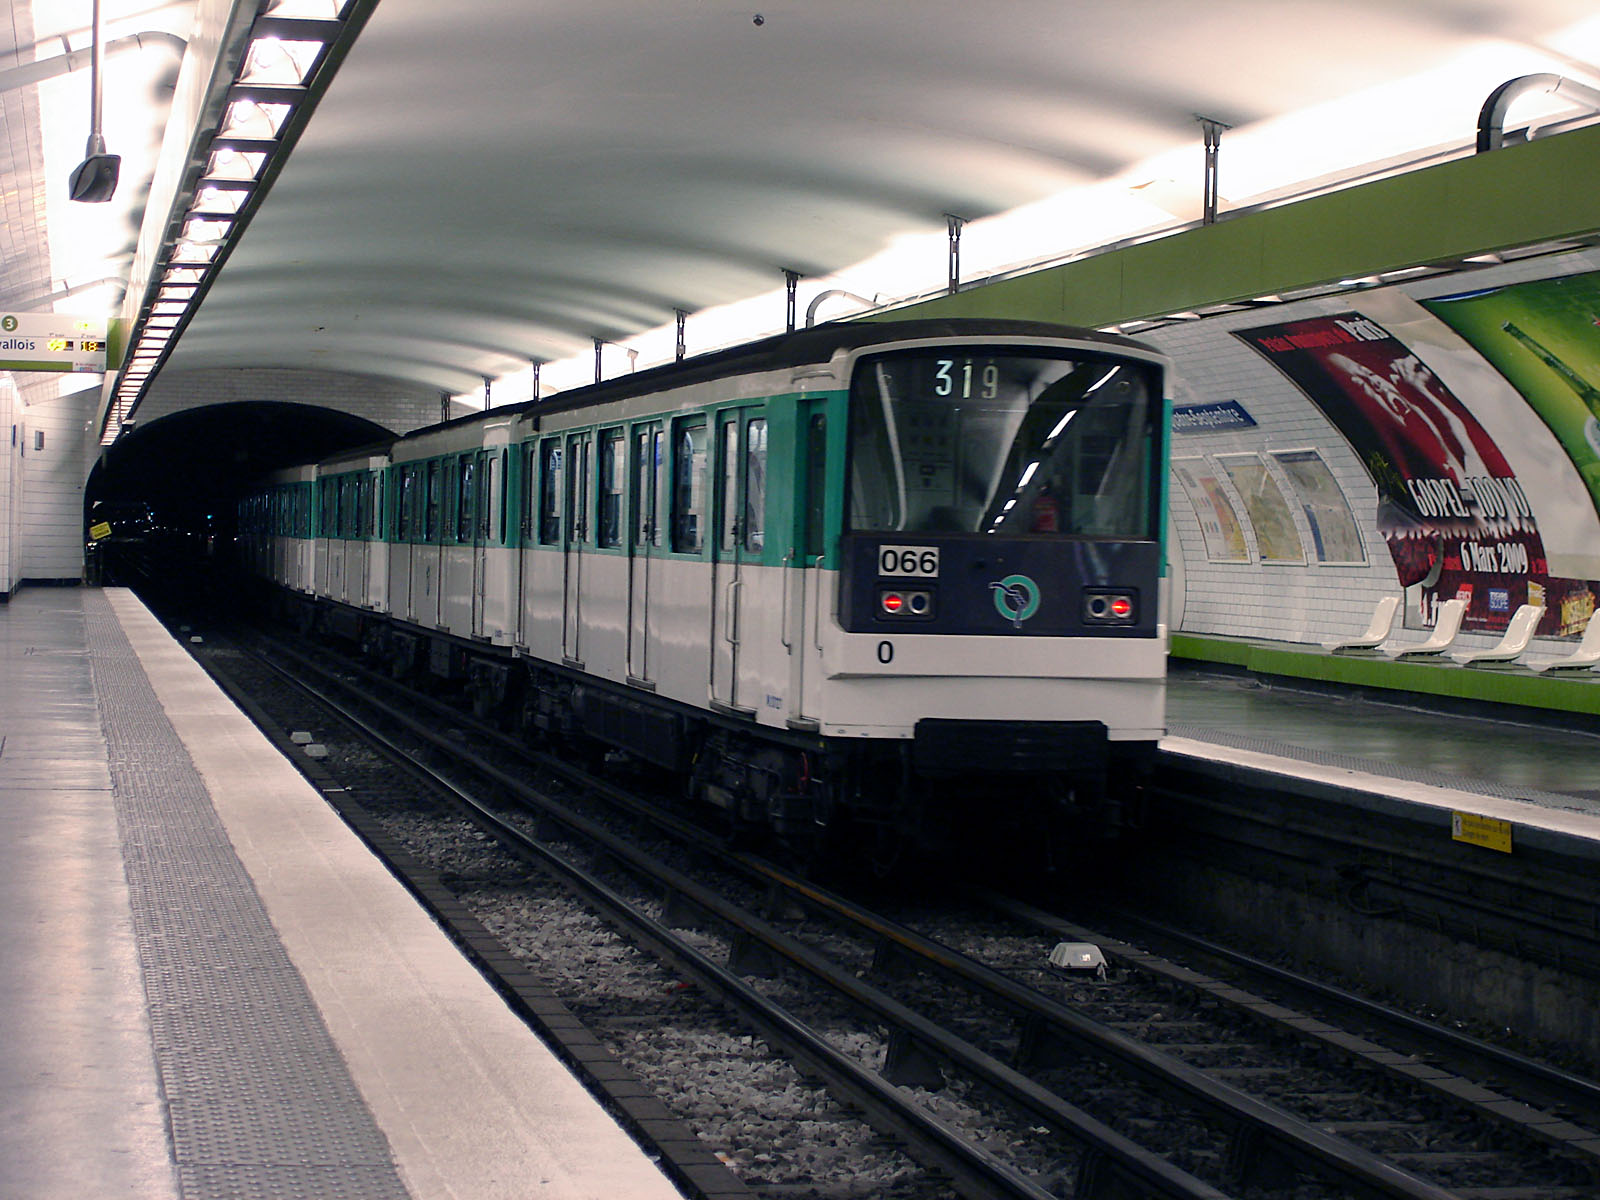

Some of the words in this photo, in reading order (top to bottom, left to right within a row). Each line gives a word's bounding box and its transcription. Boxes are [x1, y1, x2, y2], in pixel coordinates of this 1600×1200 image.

[5, 317, 14, 330] 3
[1333, 317, 1391, 342] Paris
[934, 359, 999, 399] 319
[1407, 478, 1470, 517] GOSPEL
[881, 550, 937, 575] 066
[1460, 541, 1471, 572] 6
[1469, 541, 1498, 573] Mars
[1497, 542, 1529, 575] 2009
[877, 641, 894, 664] 0
